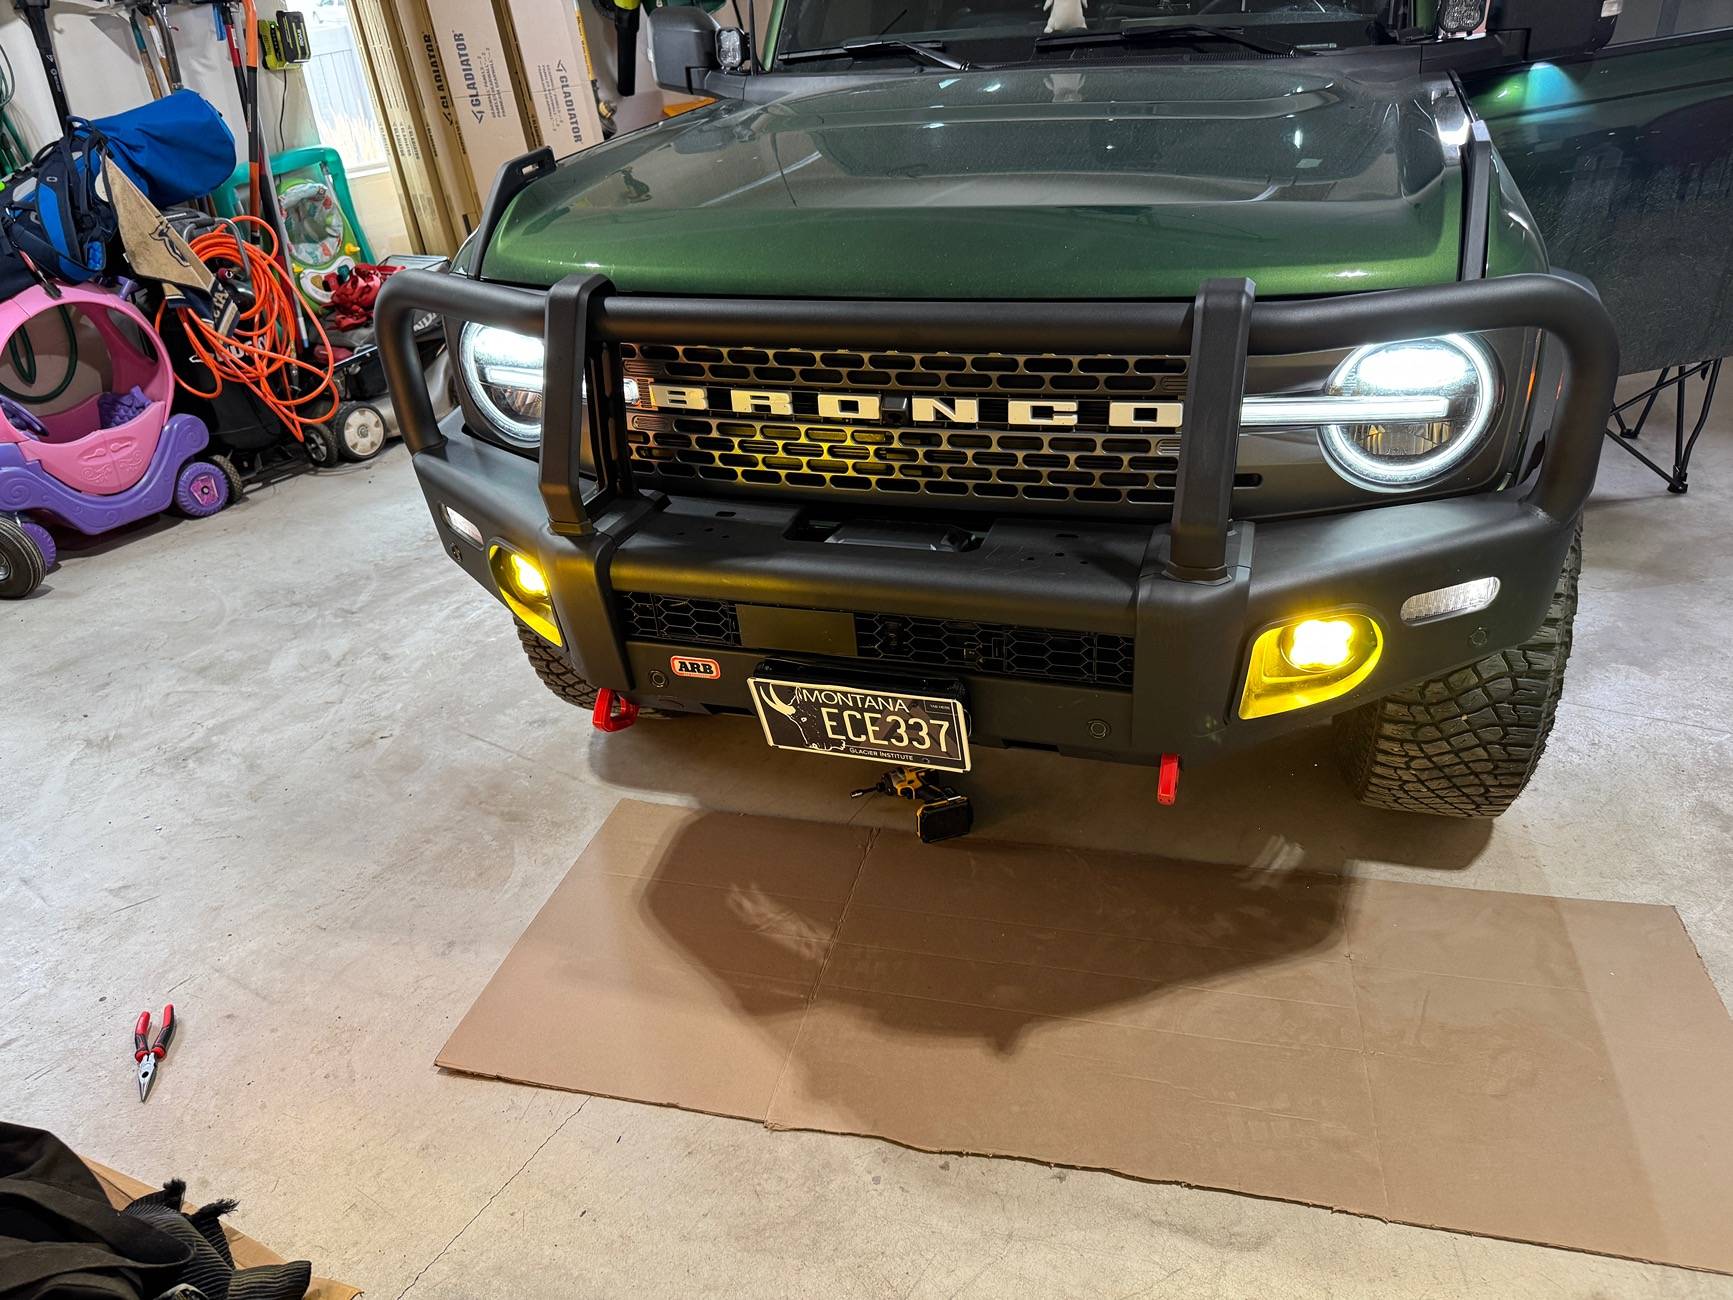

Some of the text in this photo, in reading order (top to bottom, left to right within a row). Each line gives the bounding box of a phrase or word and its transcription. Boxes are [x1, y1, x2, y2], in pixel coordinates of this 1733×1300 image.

[454, 32, 481, 107] GLADIATOR
[560, 75, 583, 143] GLADIATOR
[651, 384, 1184, 428] BRONCO
[678, 661, 714, 675] ARB
[802, 689, 910, 713] MONTANA
[821, 707, 950, 752] ECE337
[850, 747, 914, 761] GLACIER INSTITUTE
